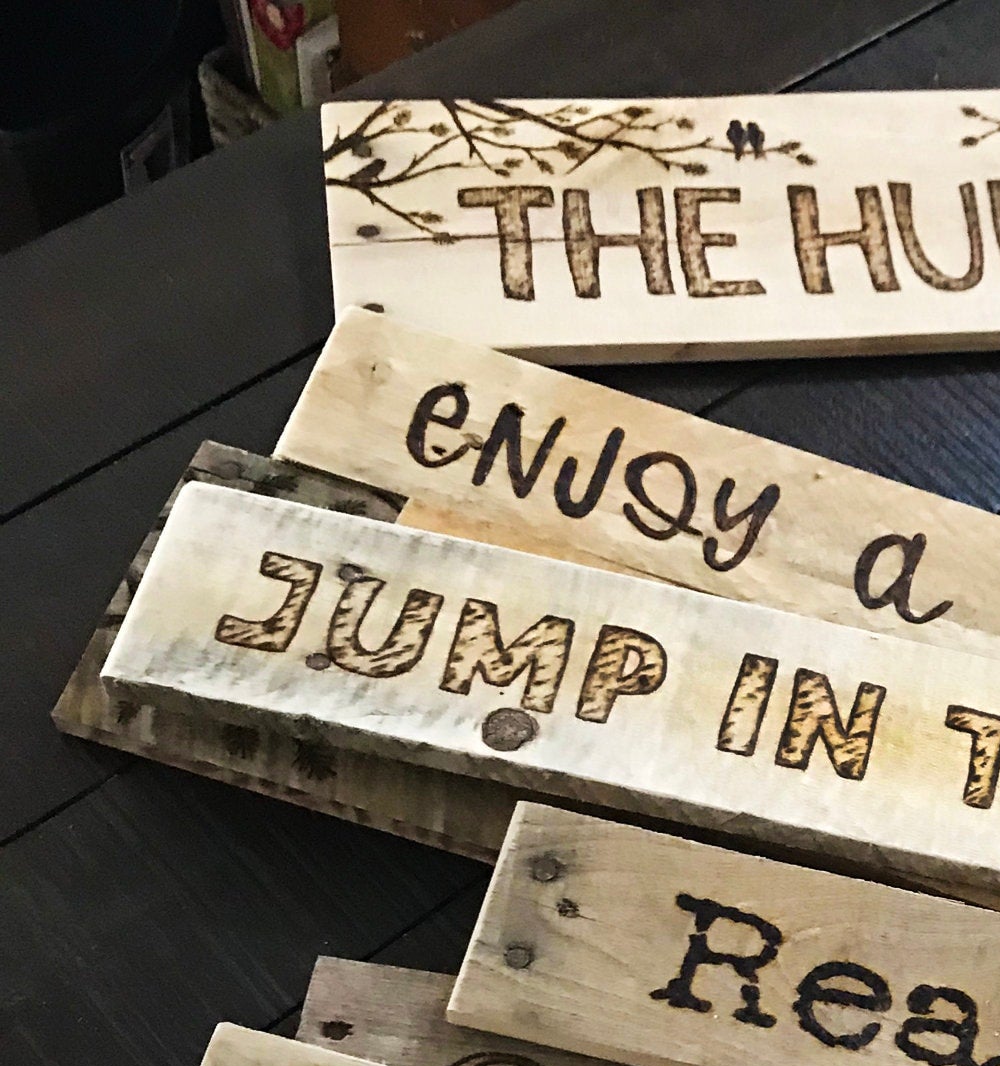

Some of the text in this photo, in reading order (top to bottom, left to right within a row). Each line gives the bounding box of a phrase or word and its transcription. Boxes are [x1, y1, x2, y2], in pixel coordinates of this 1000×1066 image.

[458, 182, 768, 301] THE
[855, 532, 955, 624] a
[214, 550, 669, 724] JUMP
[716, 652, 886, 781] IN
